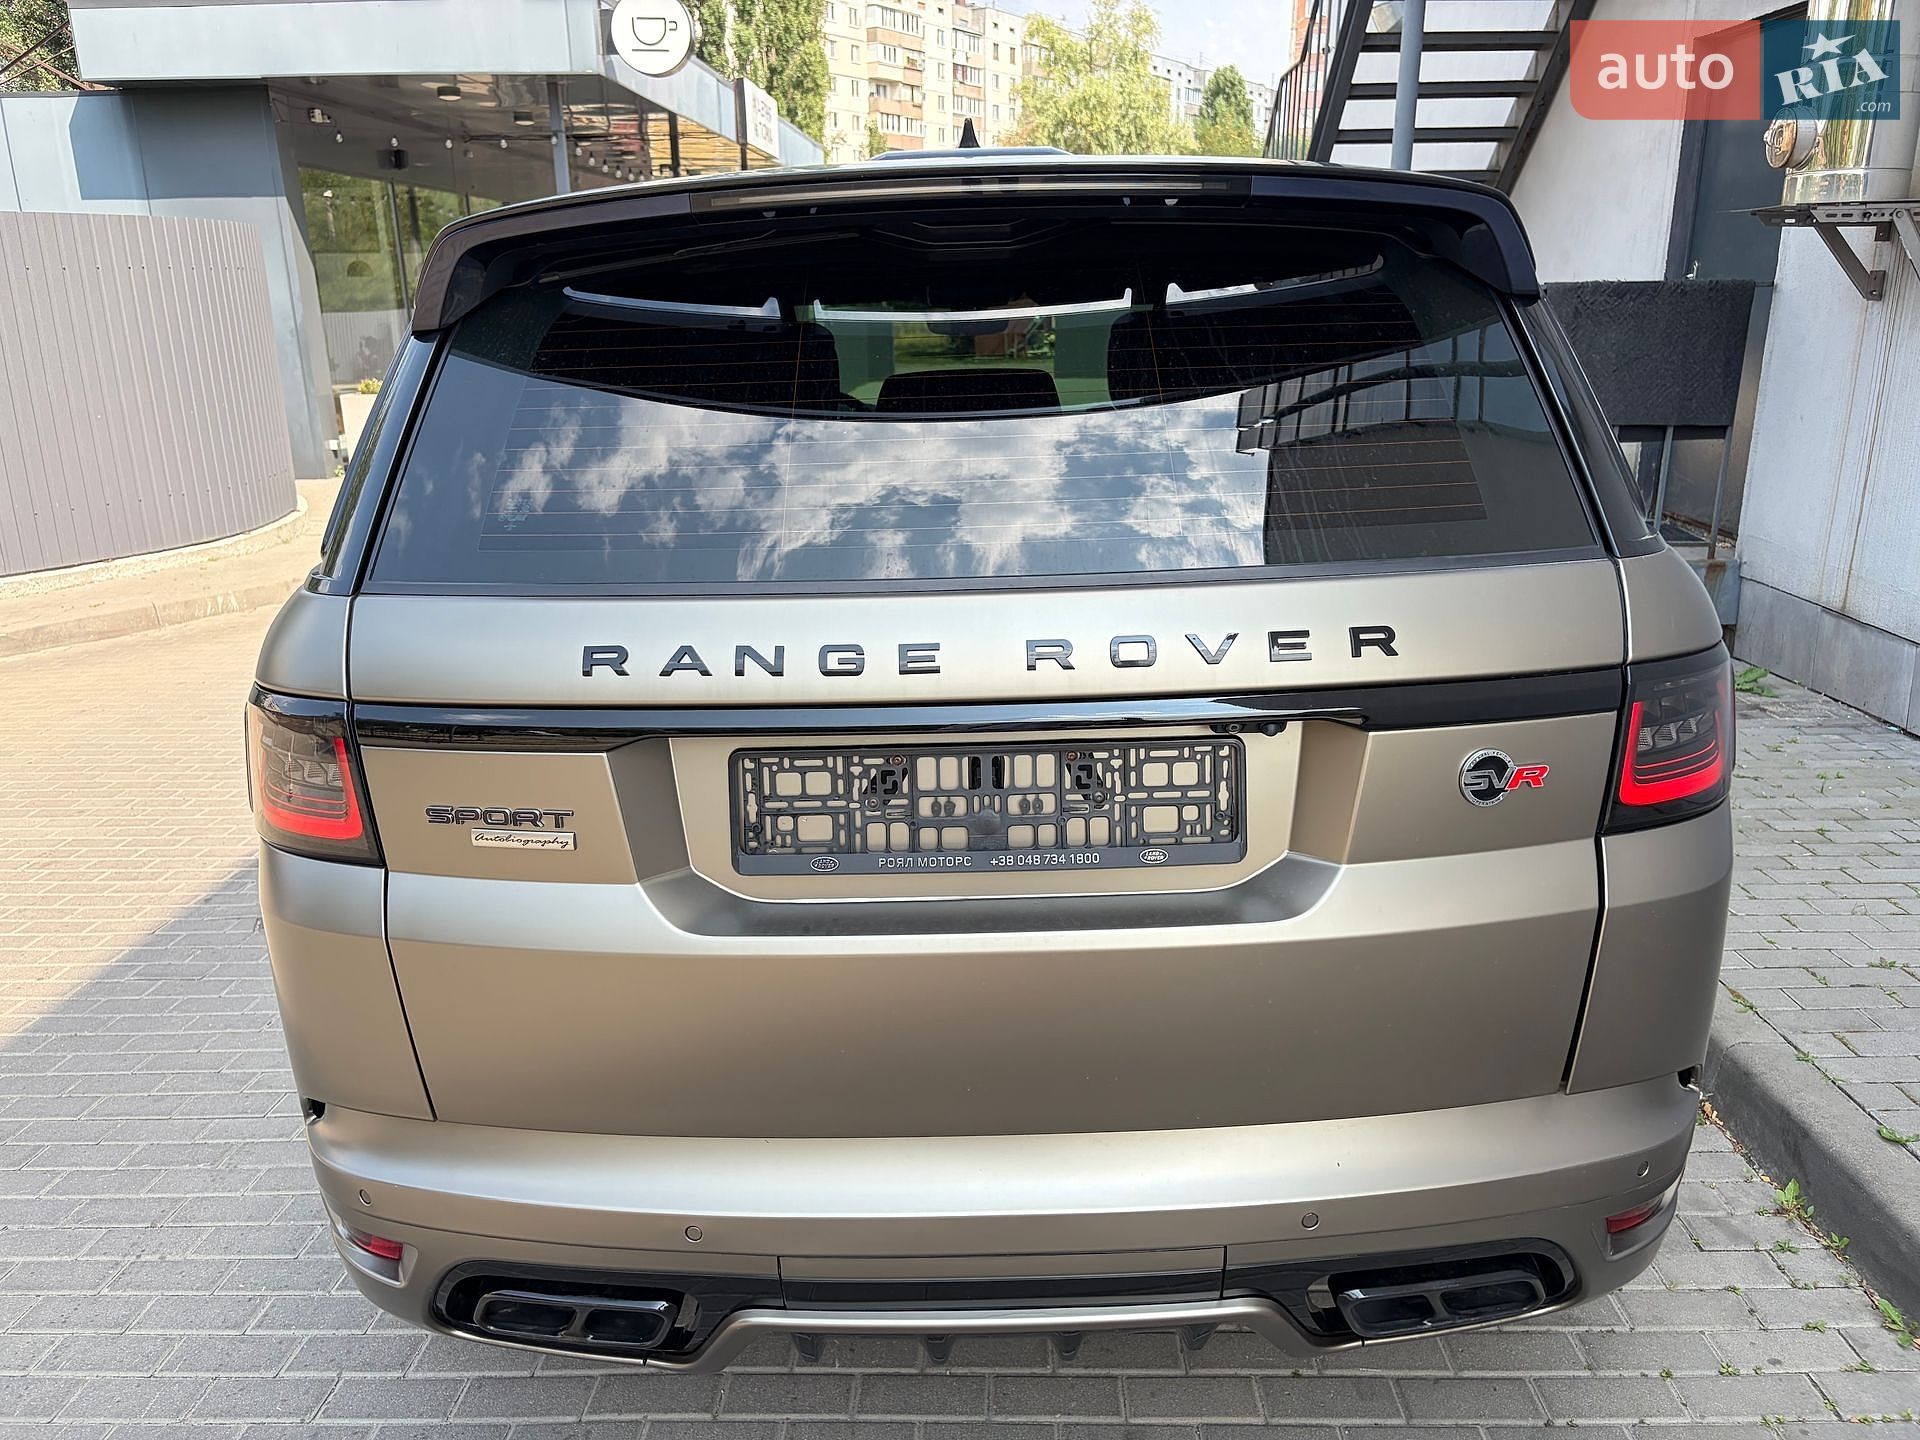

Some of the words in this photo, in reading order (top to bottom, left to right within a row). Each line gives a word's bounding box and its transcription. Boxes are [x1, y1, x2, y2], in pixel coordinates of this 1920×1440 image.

[582, 643, 941, 677] RANGE
[1026, 624, 1399, 671] ROVER
[1462, 764, 1550, 791] SVR
[425, 805, 575, 829] SPORT
[474, 832, 571, 849] Autobiography
[878, 857, 913, 868] РОЯЛ
[917, 856, 973, 868] МОТОРС
[990, 855, 1014, 867] +38
[1017, 854, 1041, 866] 048
[1043, 853, 1067, 865] 734
[1069, 852, 1100, 865] 1800
